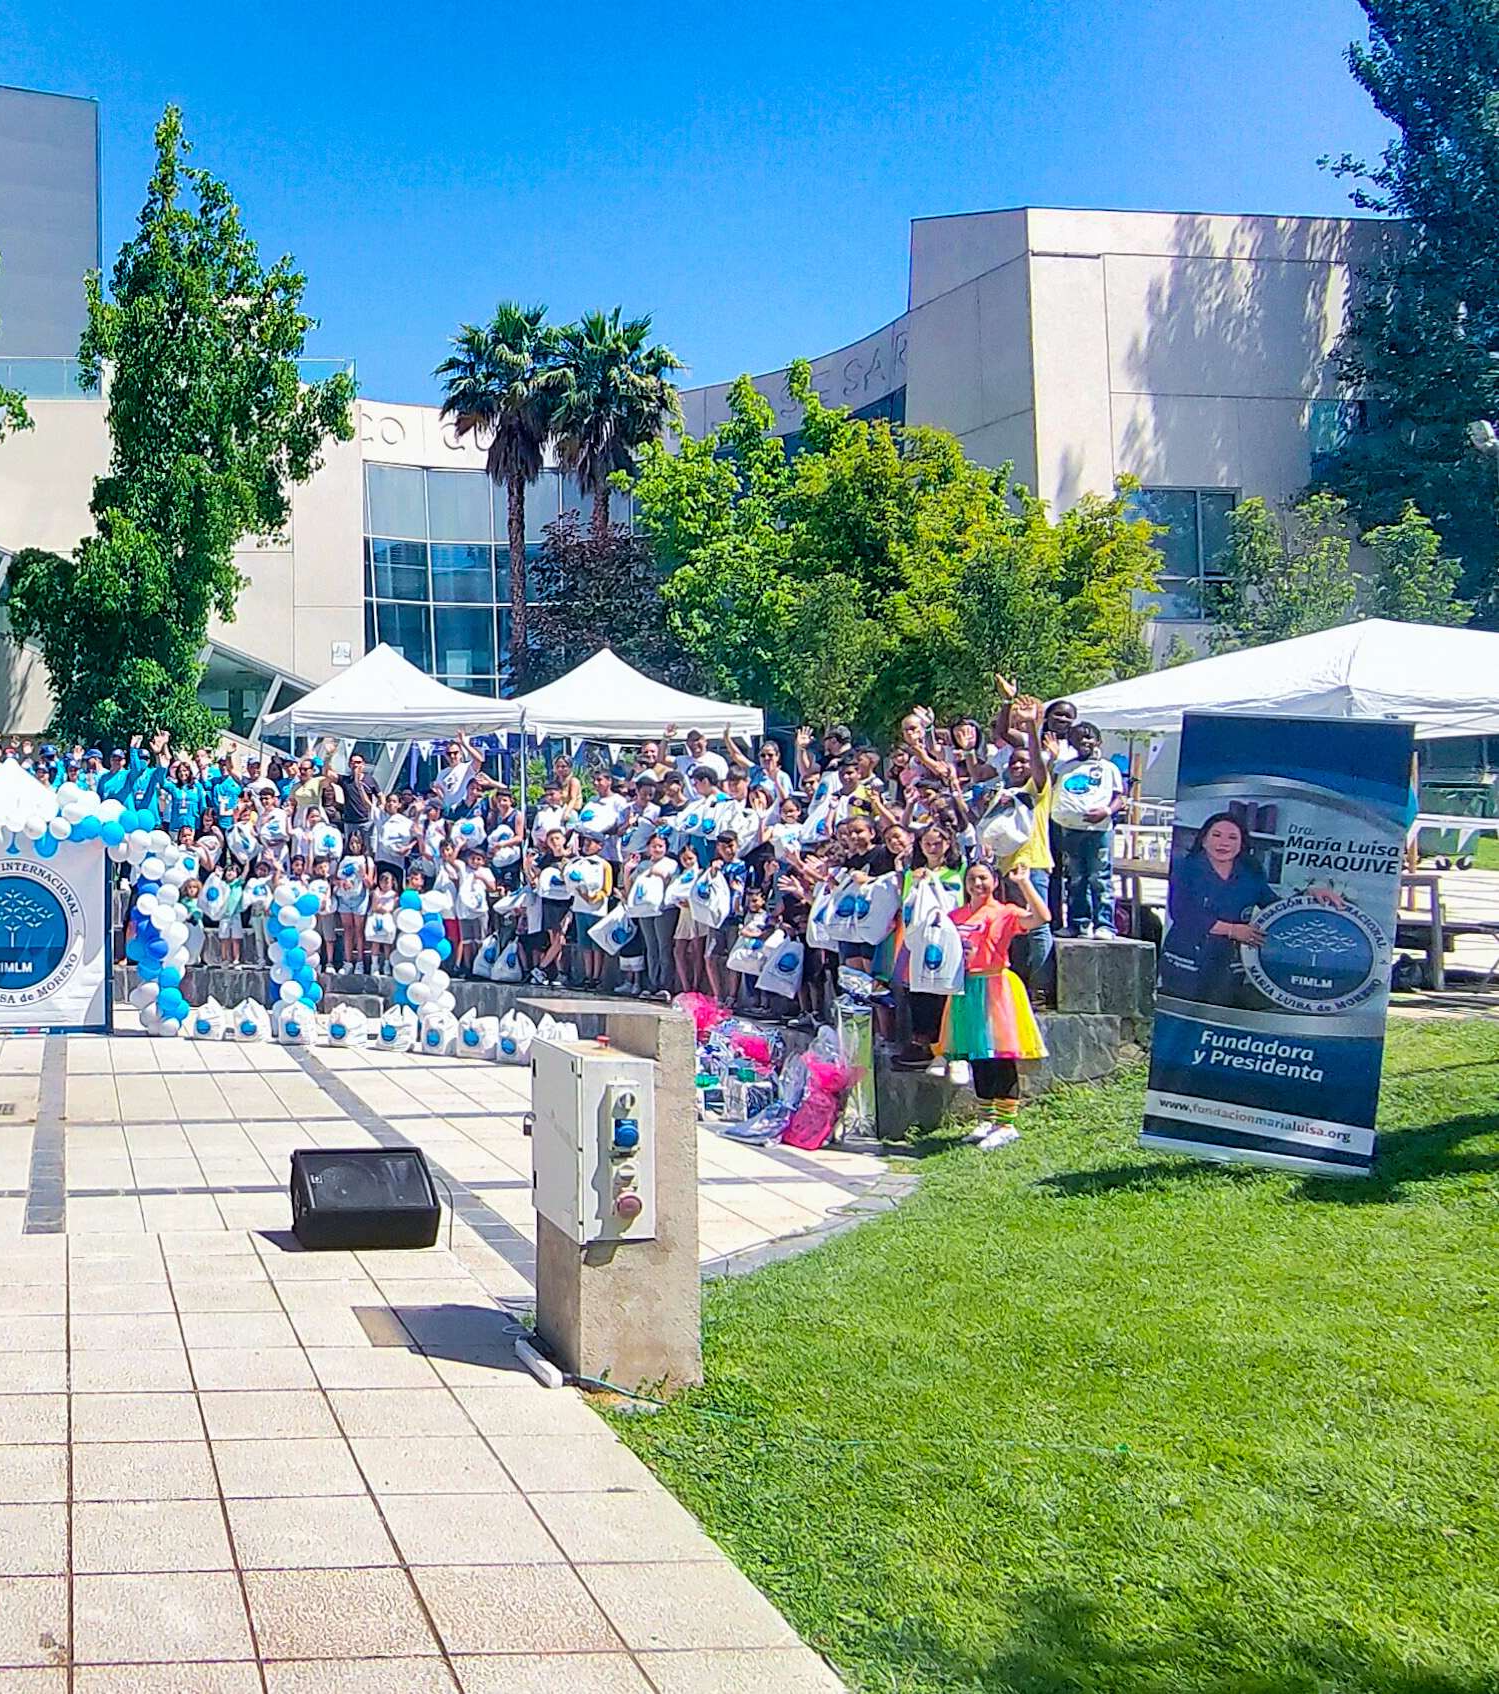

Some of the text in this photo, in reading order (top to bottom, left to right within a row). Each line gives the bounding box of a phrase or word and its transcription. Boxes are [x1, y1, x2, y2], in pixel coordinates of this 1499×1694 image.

[1285, 835, 1400, 857] María Luisa
[1284, 851, 1399, 875] PIRAQUIVE
[1, 861, 80, 918] INTERNACIONAL
[19, 993, 35, 1004] de
[37, 952, 79, 999] MORENO
[1290, 975, 1333, 989] FIMLM
[1200, 1030, 1315, 1062] Fundadora
[1191, 1049, 1324, 1083] y Presidenta
[1158, 1097, 1351, 1144] www.fundacionmarialuisa.org
